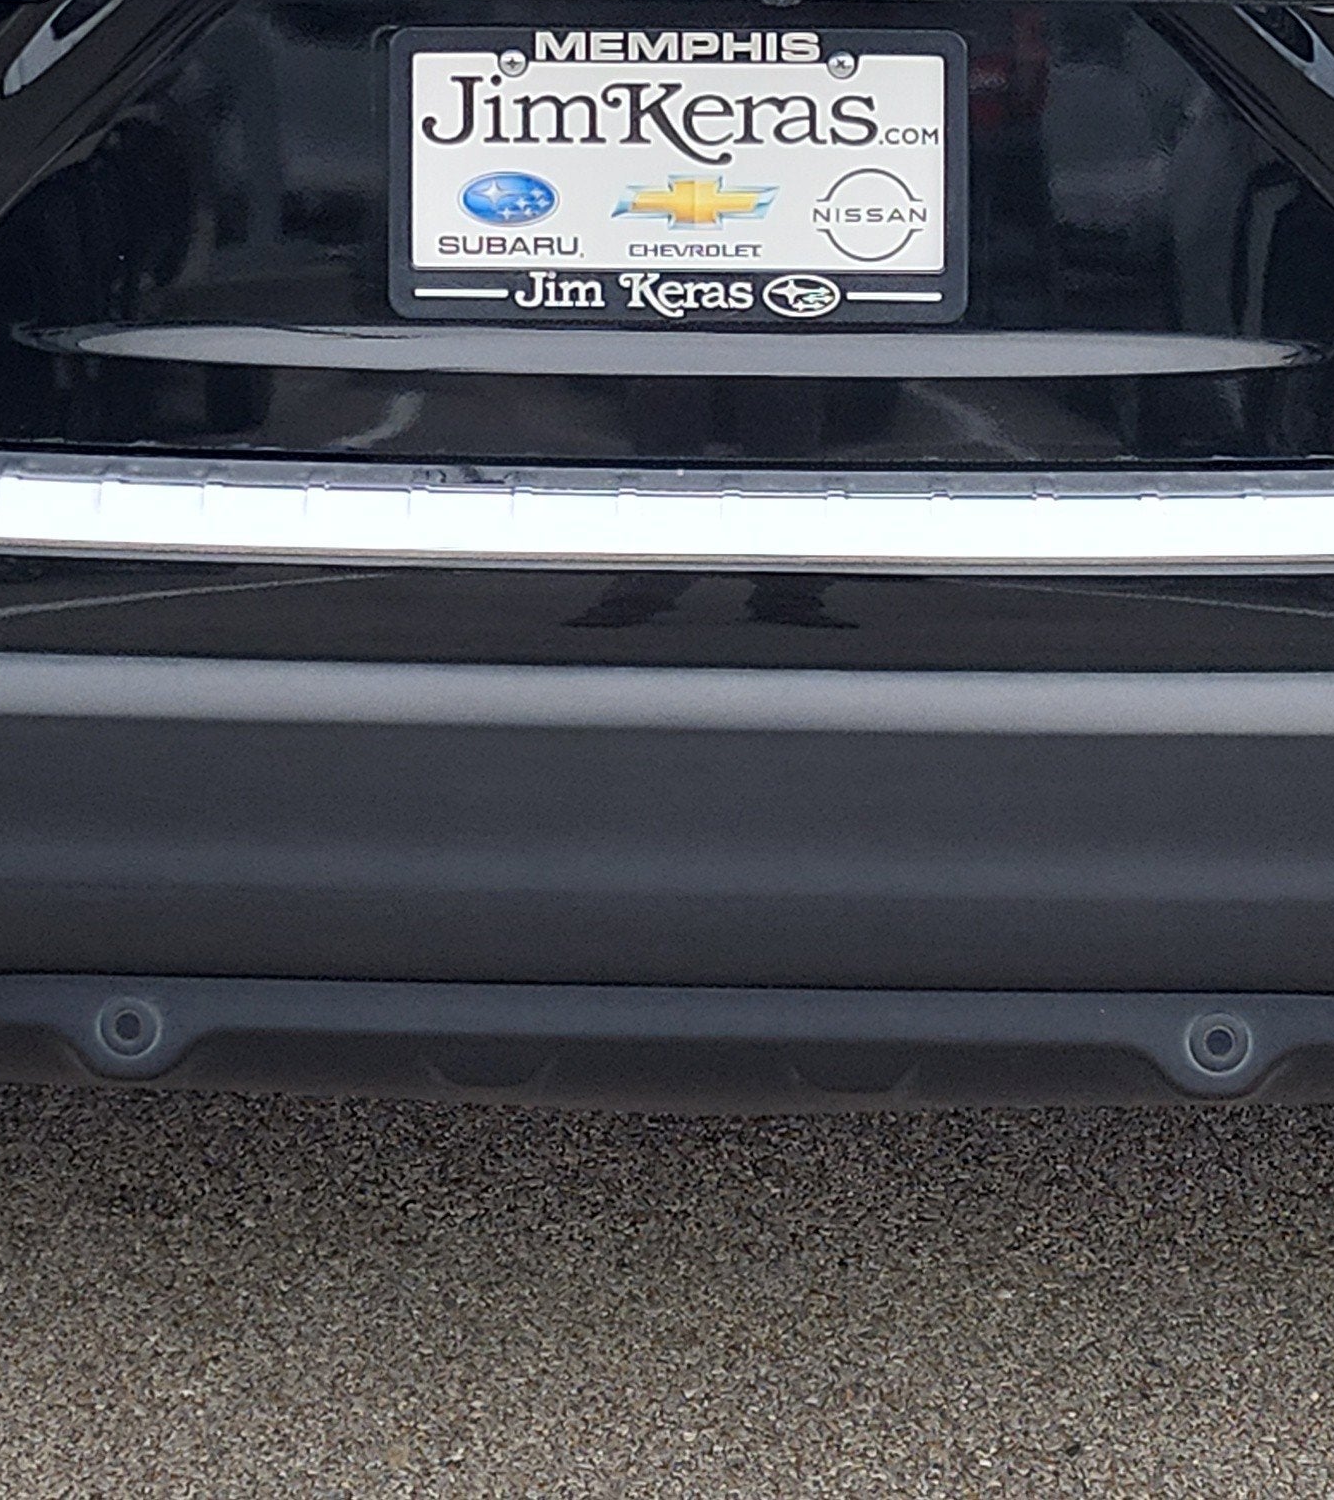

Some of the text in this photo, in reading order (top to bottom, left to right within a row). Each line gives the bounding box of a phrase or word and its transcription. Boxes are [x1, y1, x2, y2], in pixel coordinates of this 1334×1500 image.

[534, 31, 821, 62] MEMPHIS
[812, 207, 927, 223] NISSAN
[438, 236, 578, 256] SUBARU
[628, 243, 762, 258] CHEVROLET
[515, 271, 754, 318] Jim Keras
